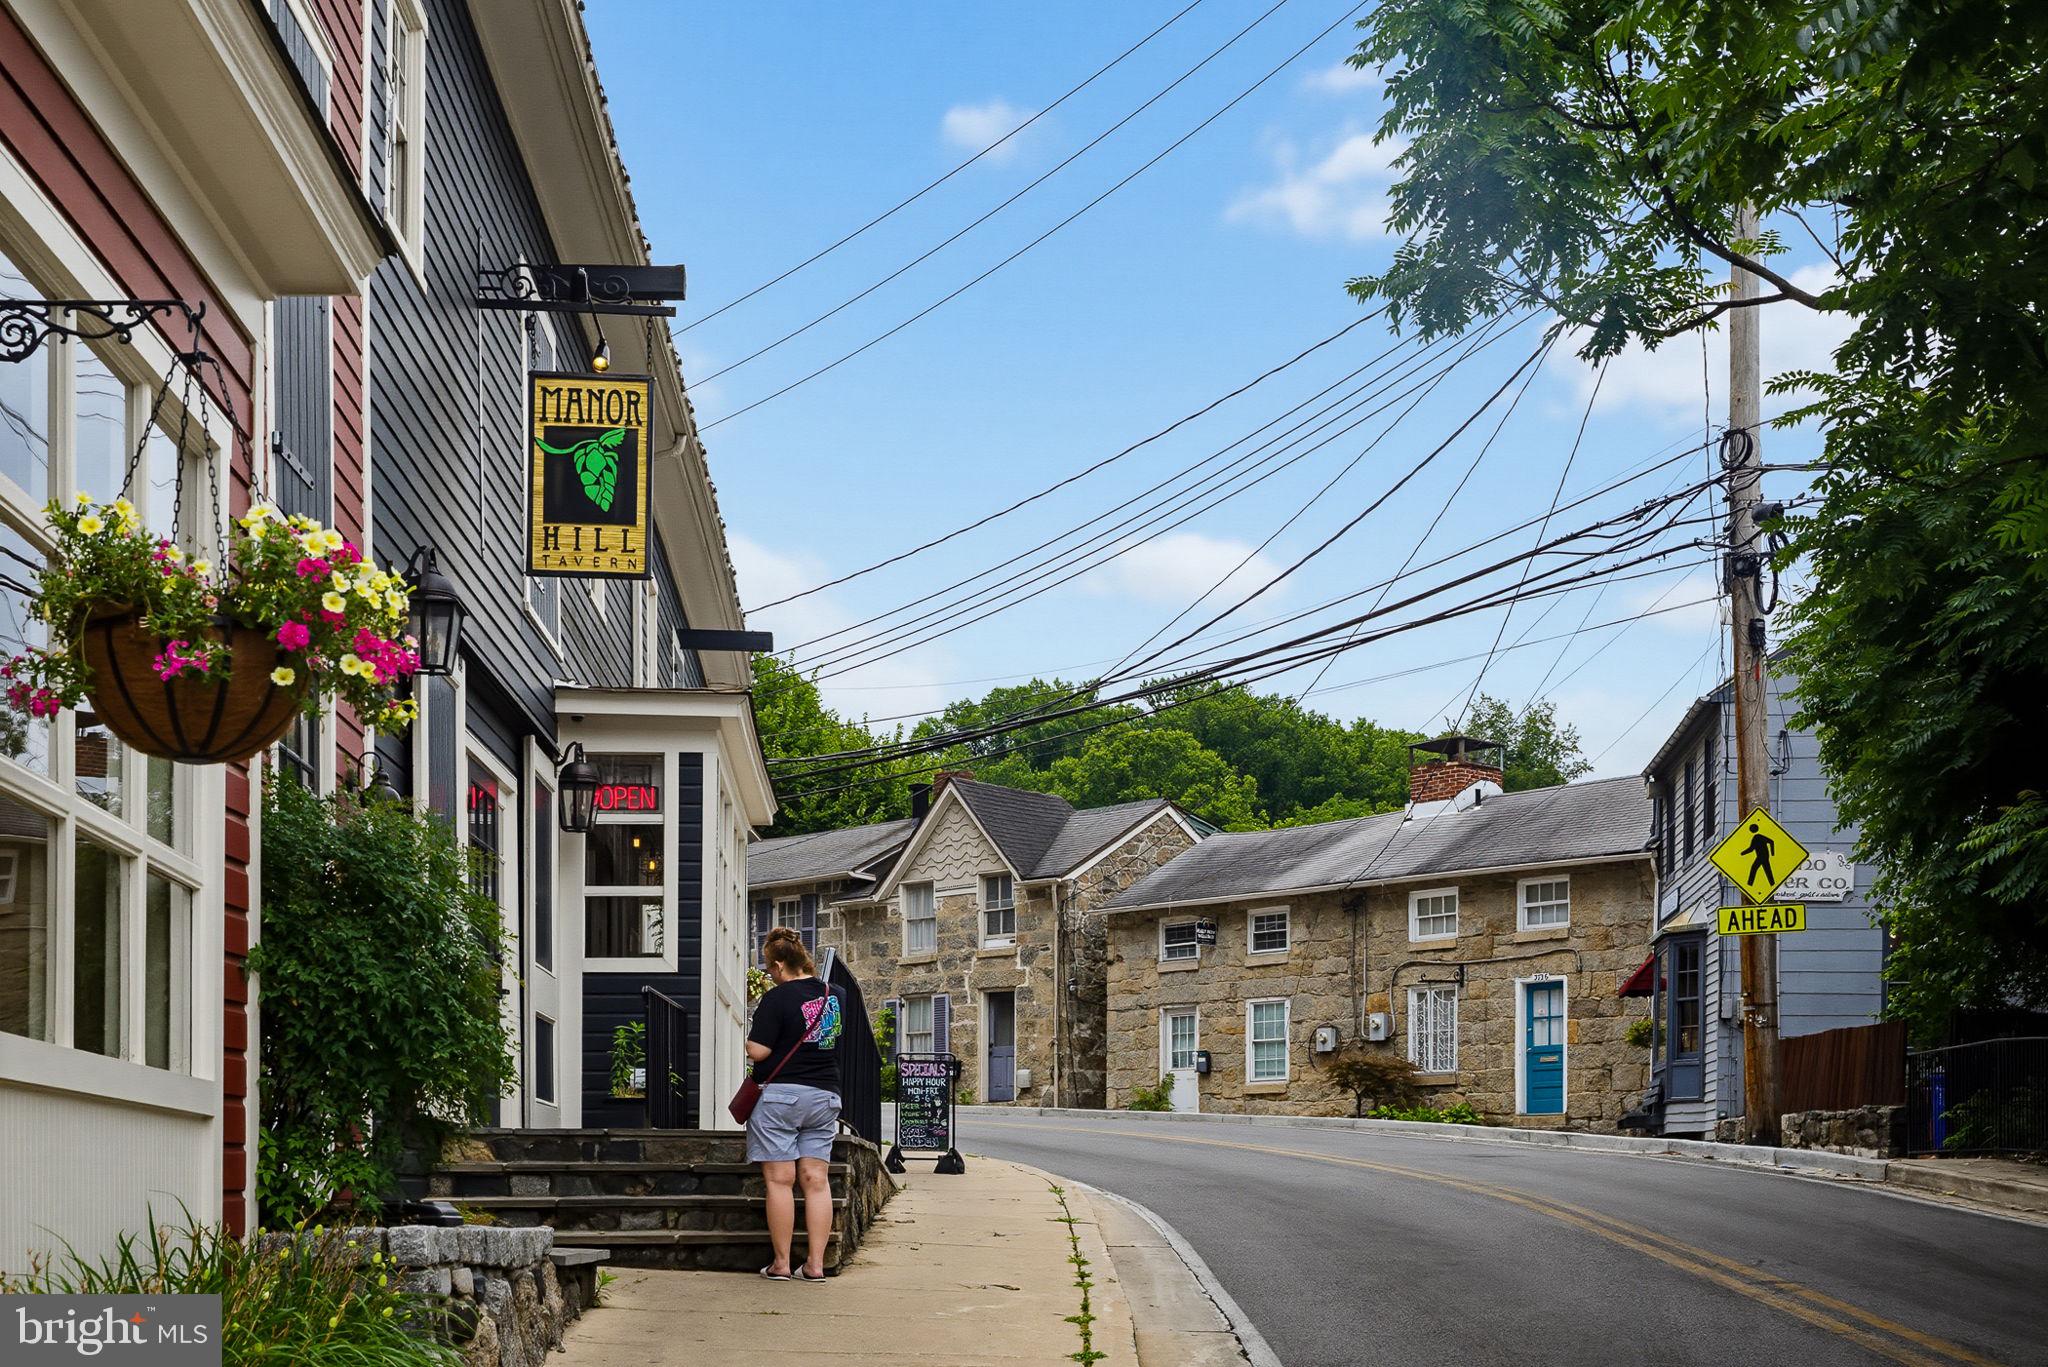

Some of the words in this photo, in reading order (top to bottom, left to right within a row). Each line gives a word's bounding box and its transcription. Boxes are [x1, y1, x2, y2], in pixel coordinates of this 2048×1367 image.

[539, 386, 642, 426] MANOR
[542, 526, 636, 553] HILL
[542, 554, 637, 569] TAVERN
[600, 785, 656, 810] OPEN
[1727, 908, 1797, 932] AHEAD
[901, 1062, 946, 1077] SPECIALS
[902, 1077, 924, 1086] HAPPY
[925, 1077, 946, 1087] HOUR
